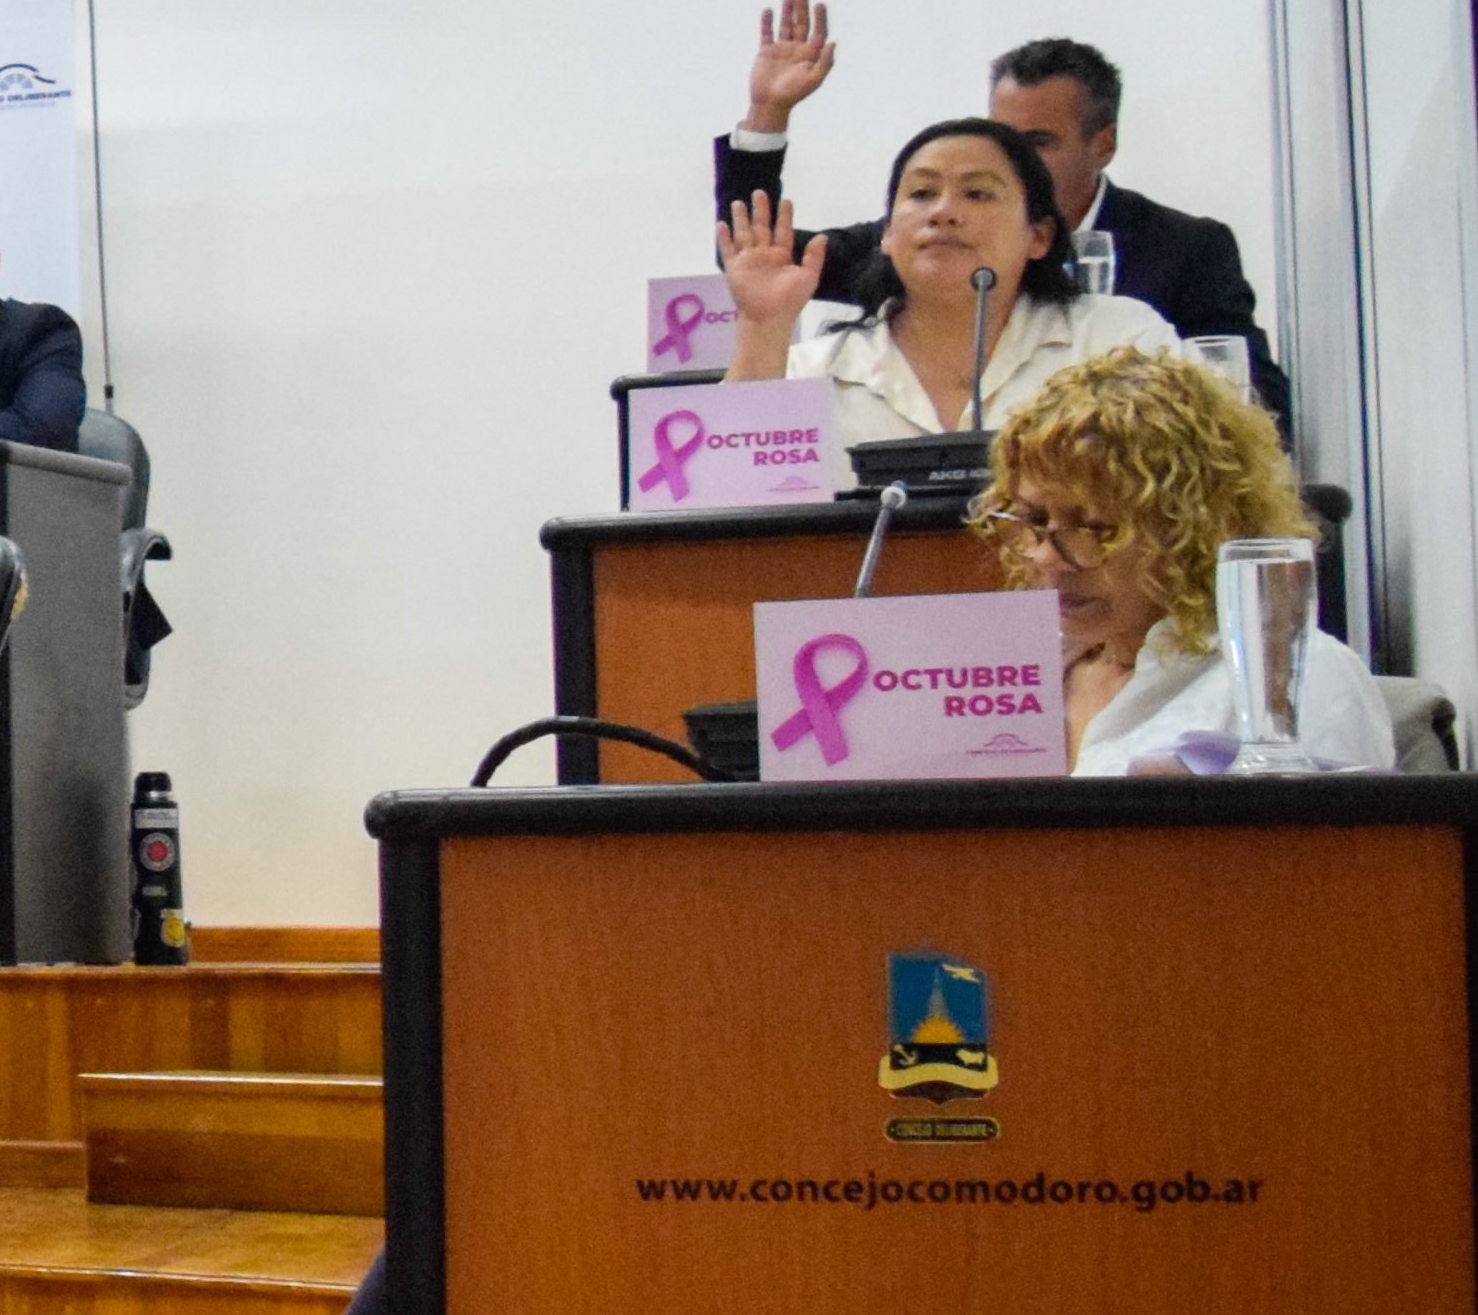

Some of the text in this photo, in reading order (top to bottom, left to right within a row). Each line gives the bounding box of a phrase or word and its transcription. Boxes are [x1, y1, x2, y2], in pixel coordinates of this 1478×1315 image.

[706, 427, 820, 450] OCTUBRE
[752, 448, 820, 466] ROSA
[872, 664, 1042, 692] OCTUBRE
[943, 694, 1043, 717] ROSA
[635, 1171, 1264, 1212] www.concejocomodoro.gob.ar
